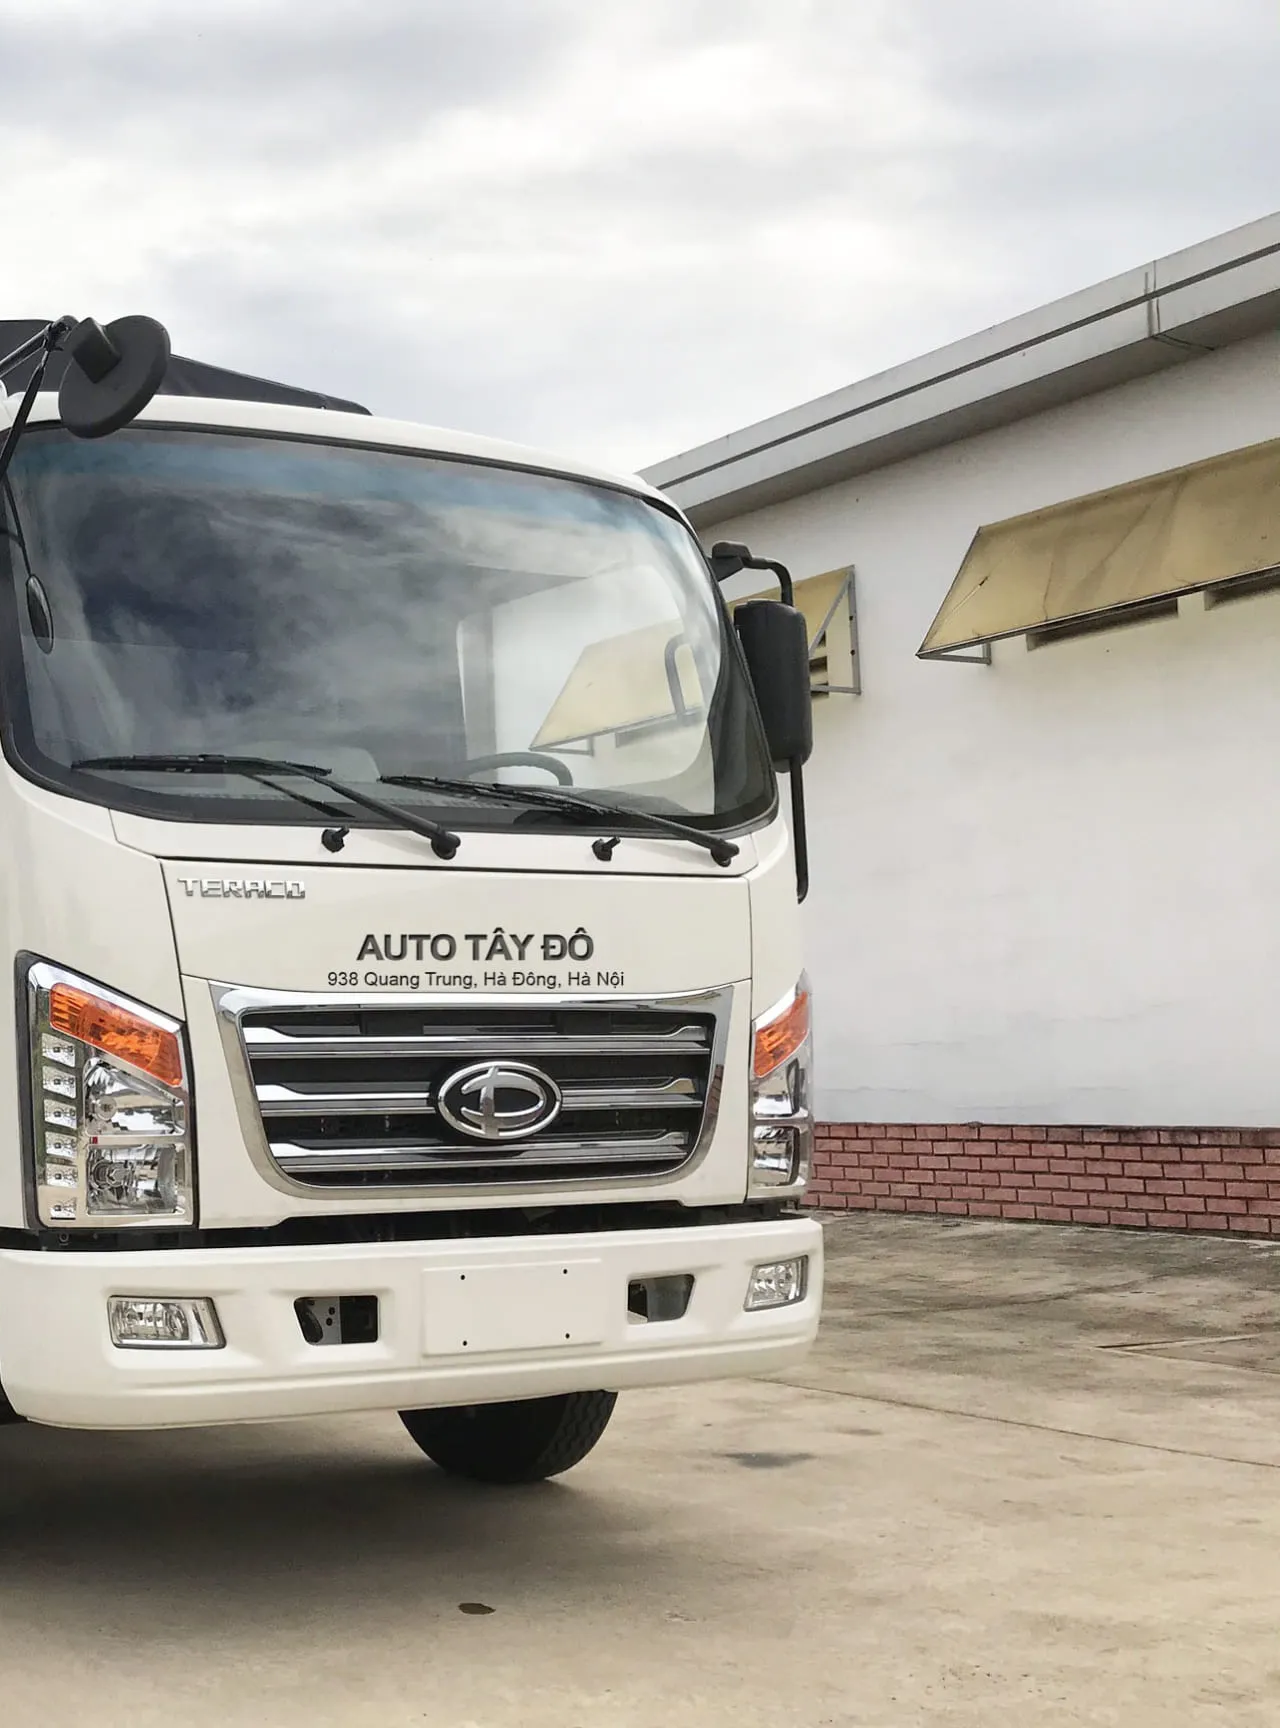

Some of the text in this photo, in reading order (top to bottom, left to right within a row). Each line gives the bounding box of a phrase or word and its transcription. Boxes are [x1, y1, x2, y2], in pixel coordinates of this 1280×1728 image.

[177, 878, 305, 899] TERACO
[356, 926, 594, 961] AUTO TÂY ĐÔ
[327, 971, 625, 989] 938 Quang Trung, Hà Đông, Hà Nội
